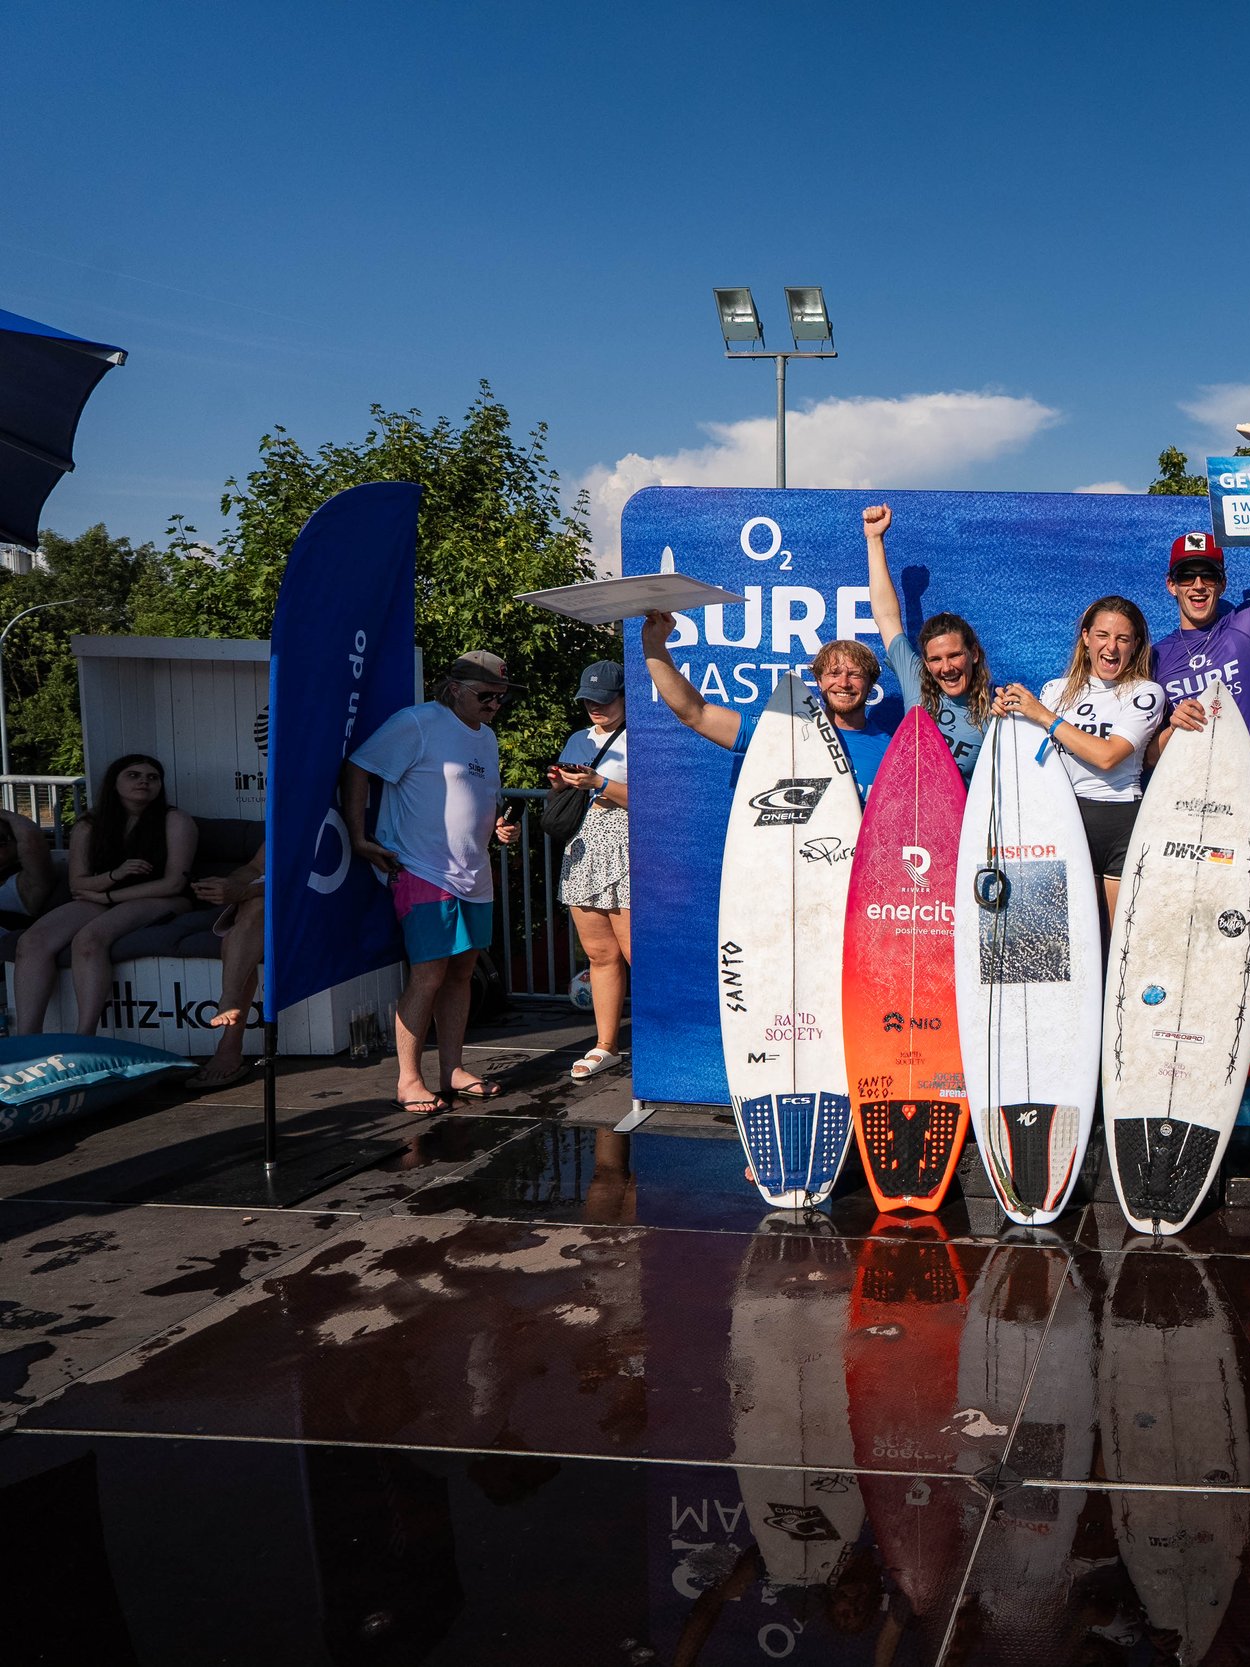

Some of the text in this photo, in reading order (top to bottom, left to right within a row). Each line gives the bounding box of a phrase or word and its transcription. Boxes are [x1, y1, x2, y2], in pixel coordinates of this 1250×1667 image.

[1231, 502, 1238, 512] 1
[740, 516, 792, 571] O2
[349, 630, 367, 680] do
[1165, 659, 1240, 701] SURF
[802, 695, 850, 776] CRANK
[468, 762, 486, 774] SURF
[235, 771, 268, 790] iri
[761, 812, 808, 821] O'NEILL
[990, 844, 1057, 859] ISITOR
[895, 927, 955, 937] positive energ
[720, 940, 748, 1013] SANTO
[101, 981, 265, 1030] ritz-koa
[774, 1012, 817, 1026] RAPID
[910, 1017, 942, 1031] NIO
[765, 1026, 824, 1042] SOCIETY
[857, 1075, 894, 1090] SANTO
[782, 1097, 811, 1105] FCS
[939, 1089, 967, 1098] arena
